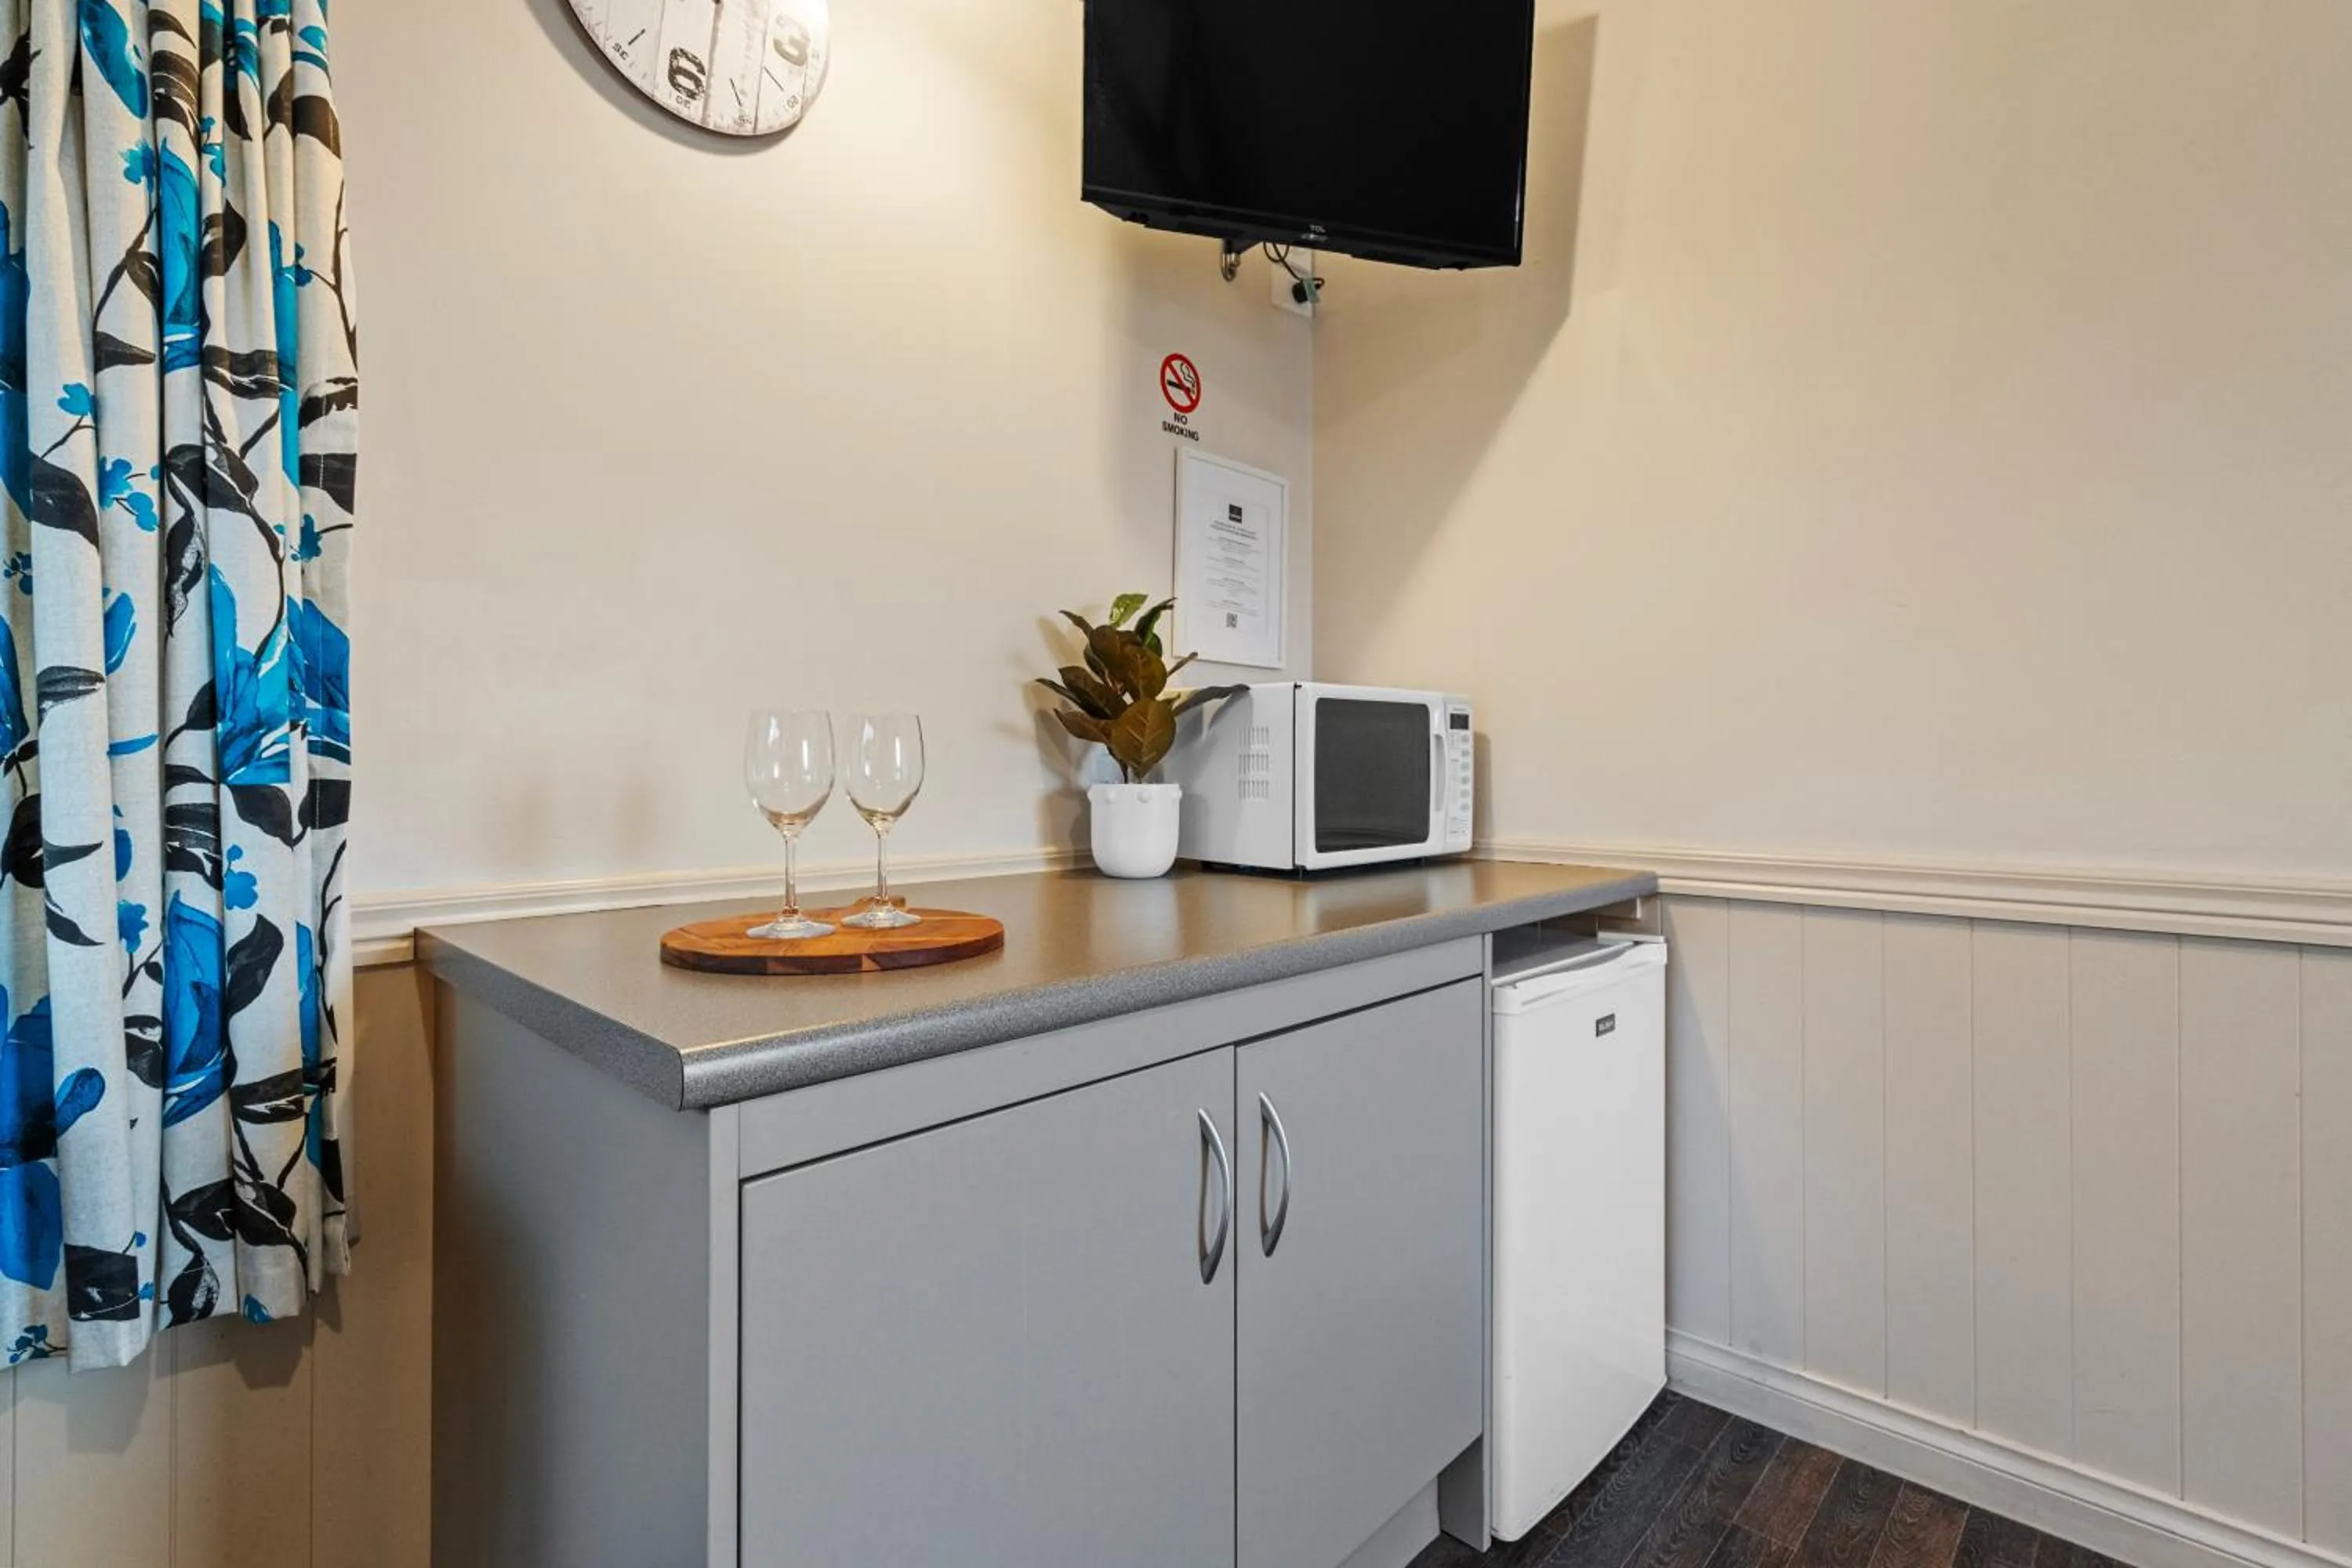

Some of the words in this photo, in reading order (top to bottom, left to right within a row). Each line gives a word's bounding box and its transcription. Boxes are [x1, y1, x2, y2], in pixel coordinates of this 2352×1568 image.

[773, 13, 811, 66] 3
[668, 48, 706, 100] 6
[1162, 420, 1199, 441] SMOKING
[1174, 412, 1188, 425] NO
